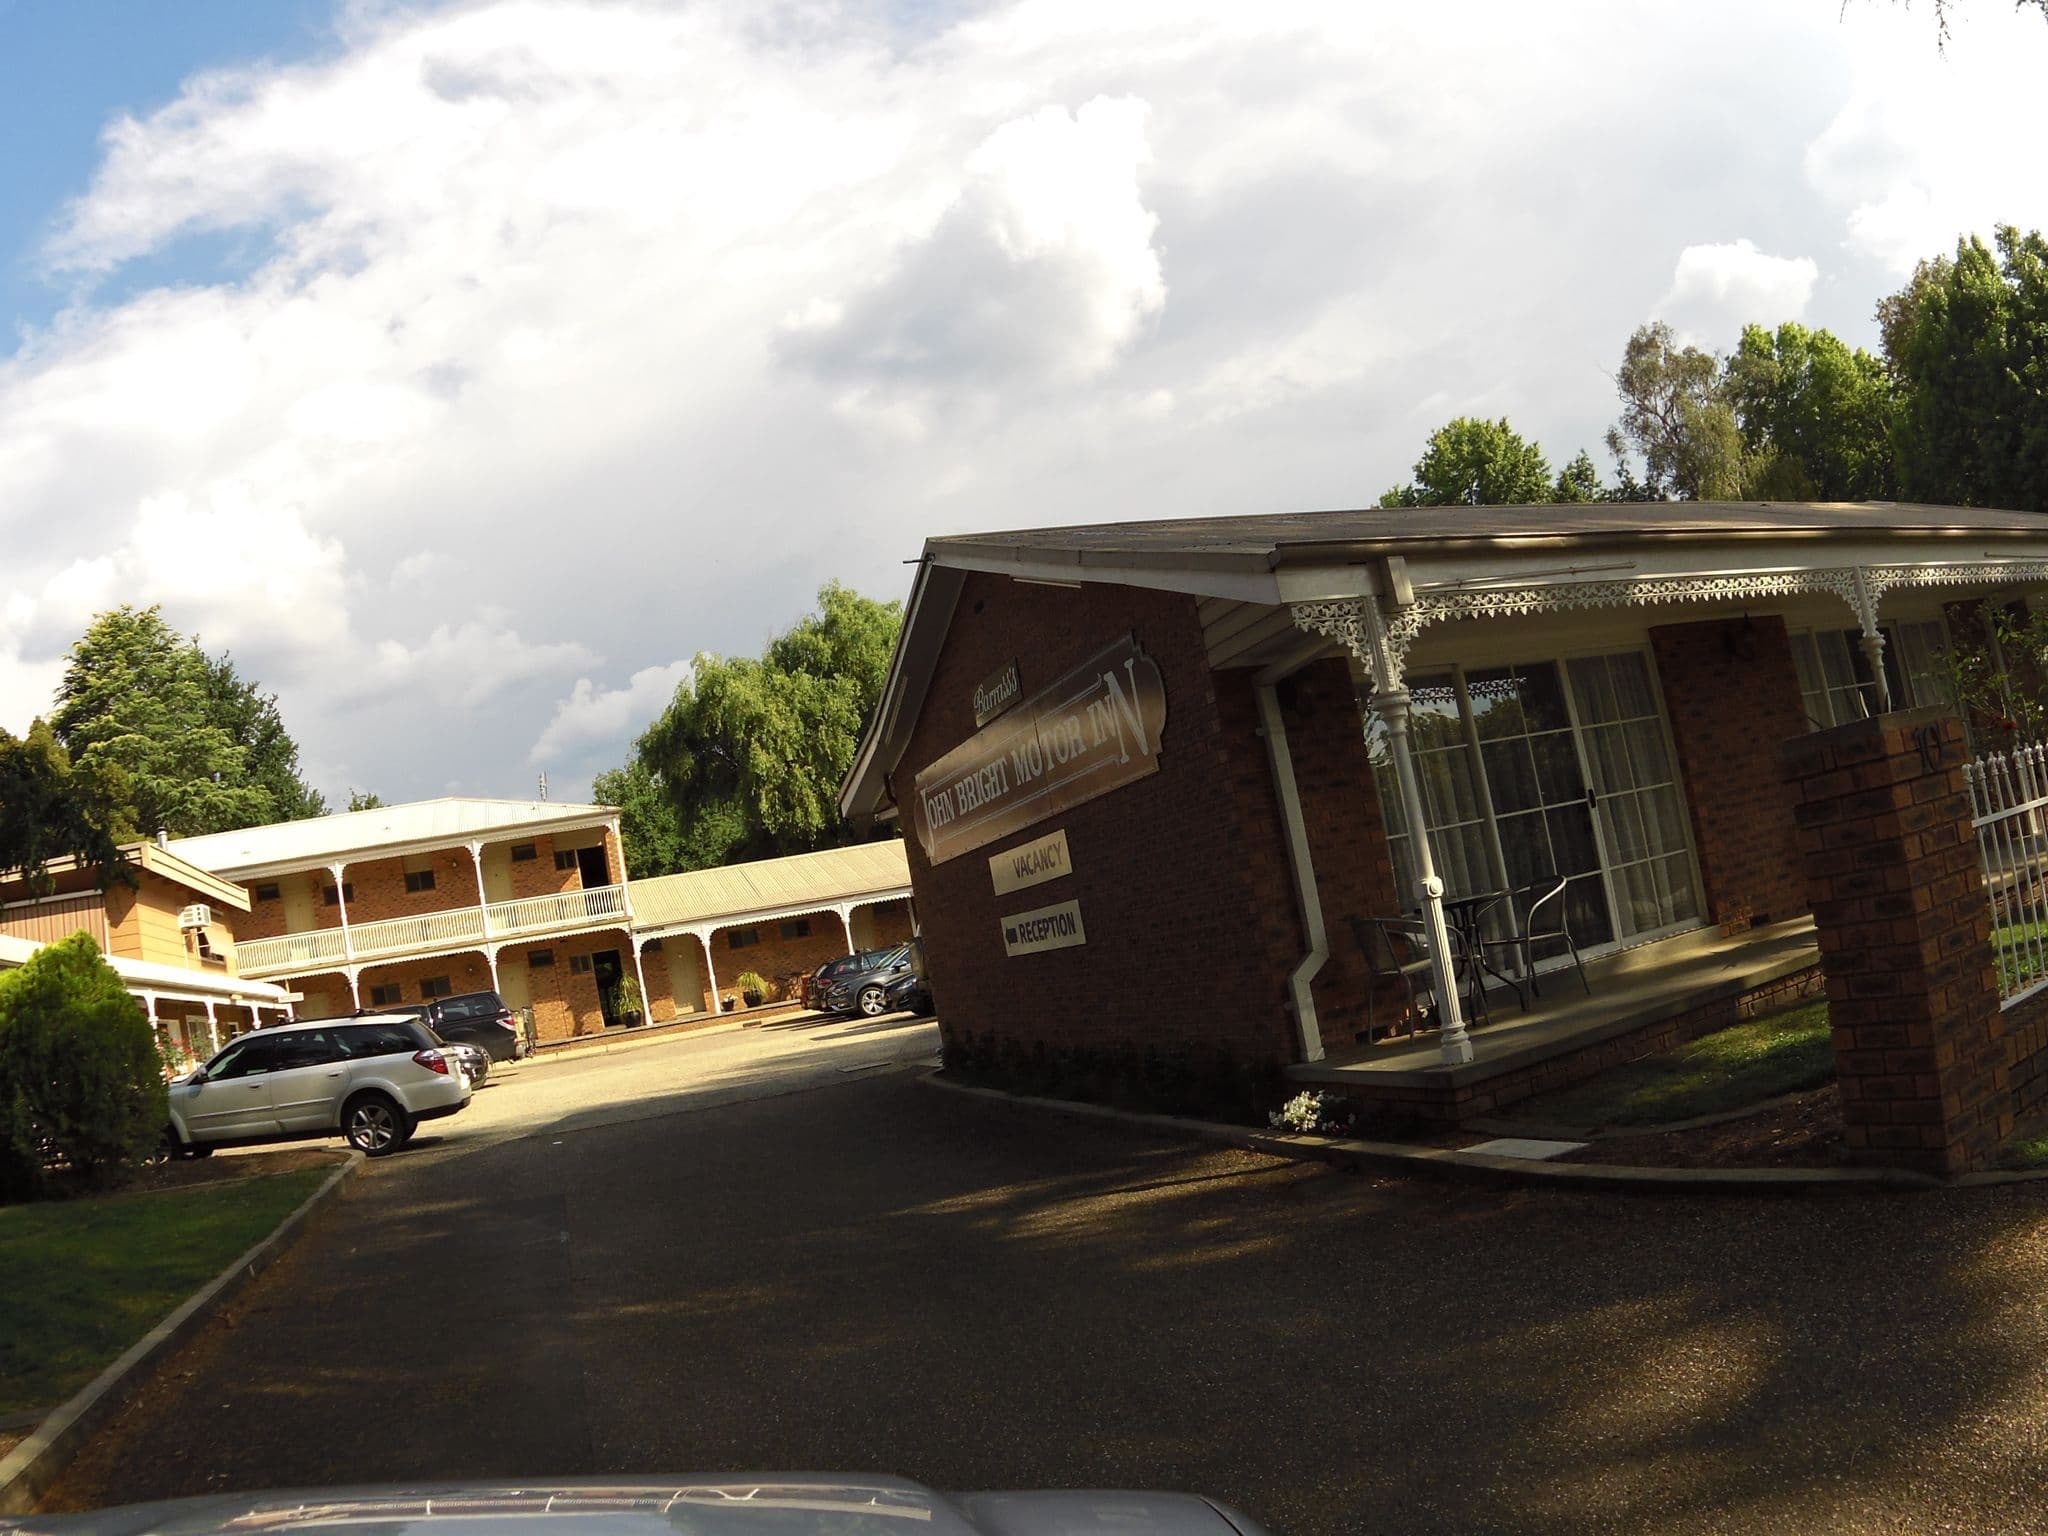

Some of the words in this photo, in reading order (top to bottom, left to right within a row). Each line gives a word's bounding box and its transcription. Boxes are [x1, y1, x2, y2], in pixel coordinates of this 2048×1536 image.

[920, 787, 956, 858] JOHN
[956, 759, 1010, 817] BRIGHT
[1013, 715, 1087, 785] MOTOR
[1086, 657, 1149, 764] INN
[1012, 841, 1063, 878] VACANCY
[1018, 911, 1076, 943] RECEPTION
